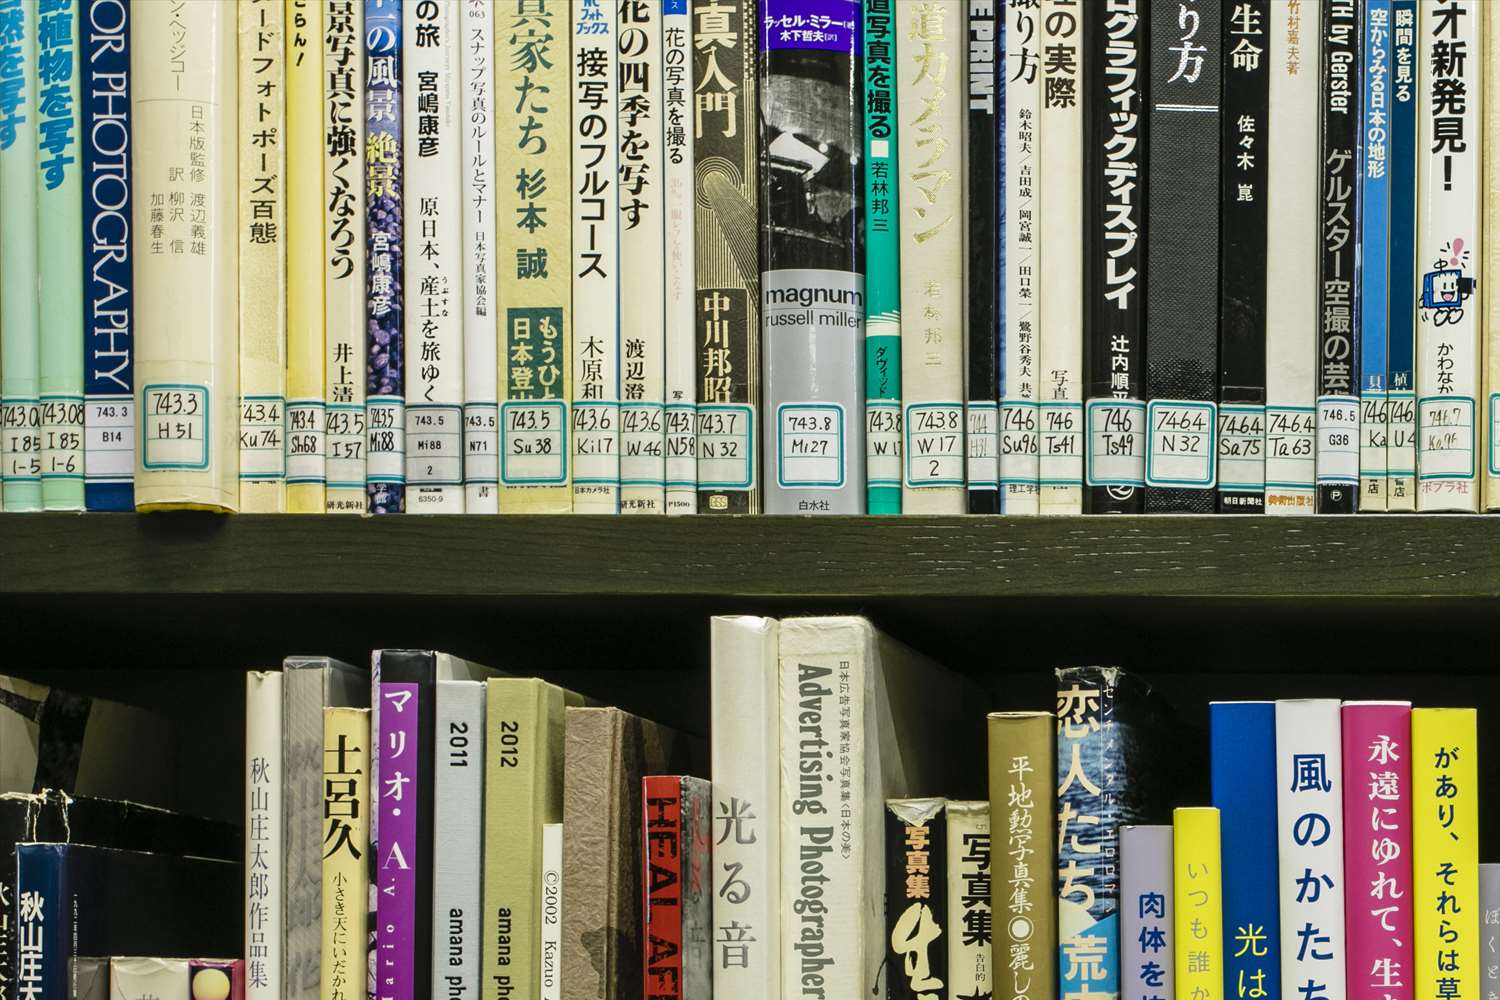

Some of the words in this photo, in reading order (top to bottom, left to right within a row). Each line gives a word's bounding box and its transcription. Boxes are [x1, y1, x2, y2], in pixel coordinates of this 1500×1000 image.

[1230, 4, 1263, 71] 生命
[1329, 24, 1353, 45] by
[1395, 9, 1413, 101] 瞬間を見る
[418, 71, 439, 157] 宮嶋康彦
[665, 27, 686, 164] 花の写真を撮る
[1331, 50, 1354, 114] Gerster
[1367, 8, 1388, 178] 空からみる日本の地形
[189, 105, 205, 182] 日本版監修
[471, 28, 488, 224] スナップ写真のルールとマナー
[1237, 115, 1255, 170] 佐々木
[577, 48, 609, 278] 接写のフルコース
[150, 192, 165, 254] 加藤春生
[517, 168, 547, 235] 杉本
[870, 161, 889, 233] 若林邦三
[90, 72, 129, 391] PHOTOGRAPHY
[517, 248, 548, 280] 誠
[765, 287, 863, 306] magnum
[765, 311, 815, 328] russell
[819, 311, 862, 328] miller
[96, 407, 128, 418] 743.3
[102, 431, 122, 442] B14
[153, 393, 197, 414] 743.3
[1329, 433, 1349, 446] G36
[450, 722, 468, 768] 2011
[501, 721, 518, 768] 2012
[792, 663, 833, 816] Advertising
[323, 735, 360, 860] 土呂久
[1056, 684, 1101, 914] 恋人たち
[248, 757, 271, 989] 秋山庄太郎作品集
[647, 798, 678, 921] HEAL
[715, 797, 757, 970] 光る音
[905, 827, 930, 898] 写真集
[450, 907, 464, 967] amana
[544, 942, 554, 988] Kazuo
